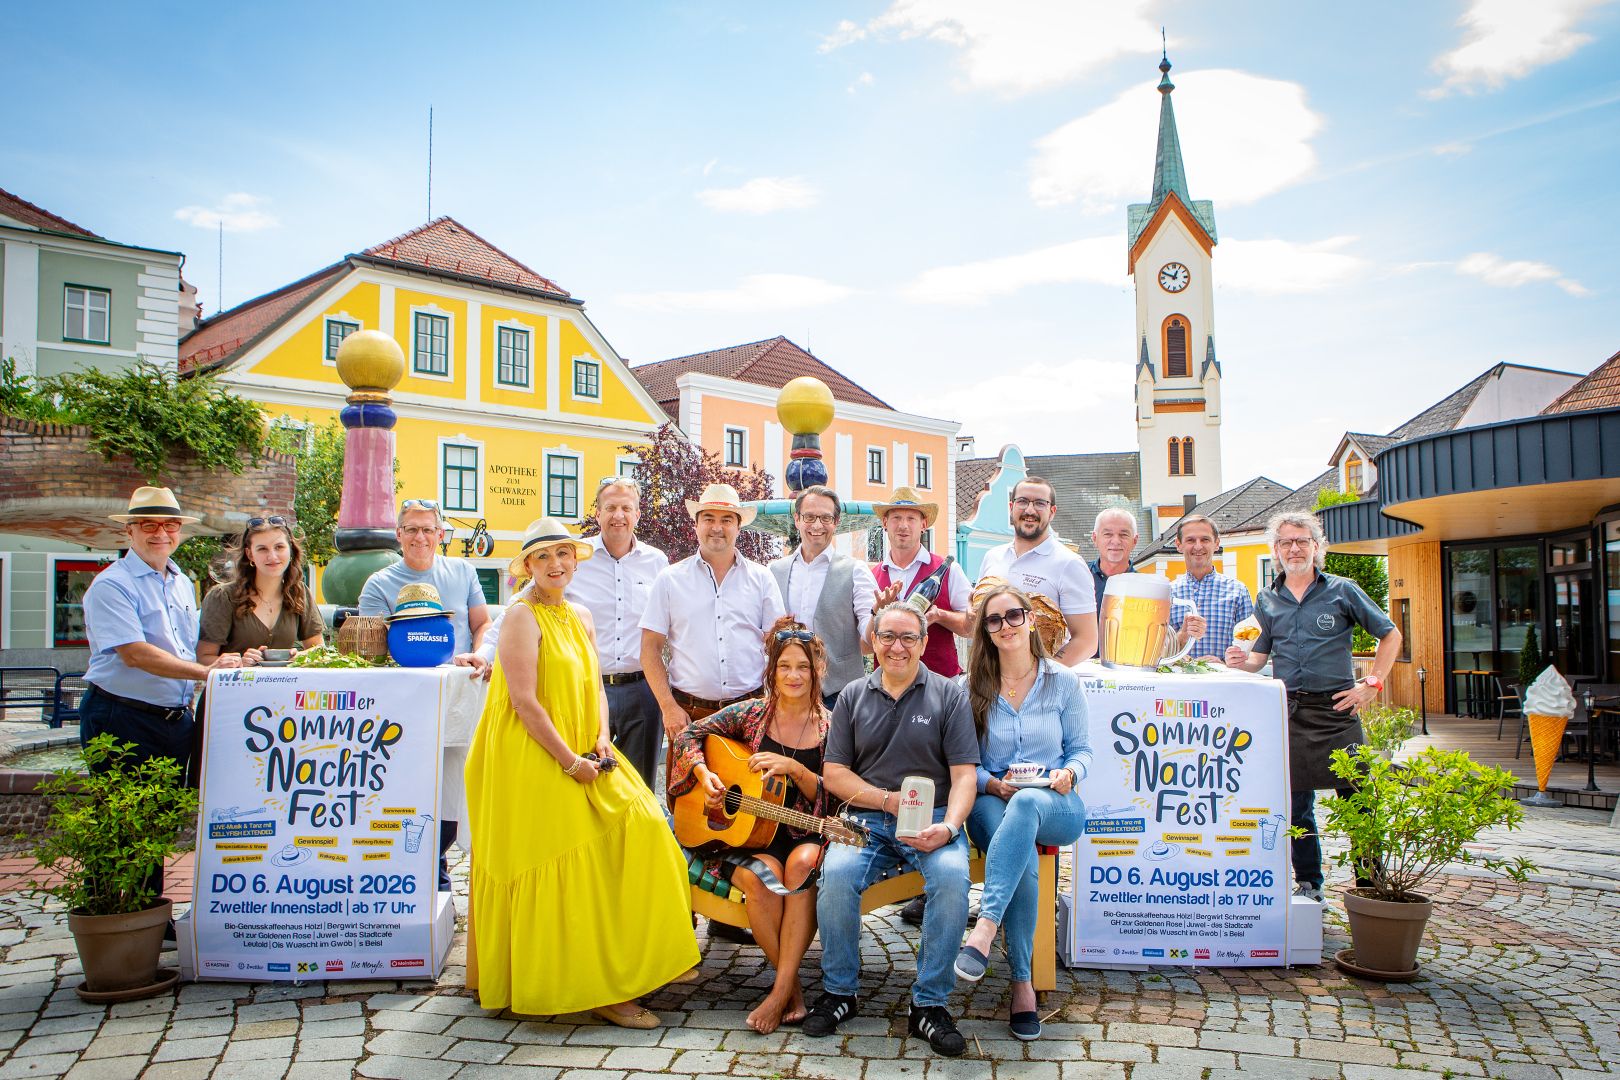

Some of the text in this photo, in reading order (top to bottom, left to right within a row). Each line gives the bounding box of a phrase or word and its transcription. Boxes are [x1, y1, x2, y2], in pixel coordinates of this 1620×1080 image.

[489, 465, 538, 477] APOTHEKE
[490, 486, 536, 496] SCHWARZEN
[256, 675, 298, 684] präsentiert
[266, 747, 387, 792] Nachts
[1135, 750, 1241, 792] Nachts
[288, 789, 366, 828] Fest
[1156, 790, 1224, 825] Fest
[1090, 866, 1274, 891] DO 6. August 2026
[212, 874, 416, 899] DO 6. August 2026
[1090, 891, 1274, 906] Zwettler Innenstadt ab 17 Uhr
[210, 901, 416, 914] Zwettler Innenstadt ab 17 Uhr
[1103, 911, 1175, 919] Bio-Genusskaffeehaus
[327, 922, 358, 931] Bergwirt
